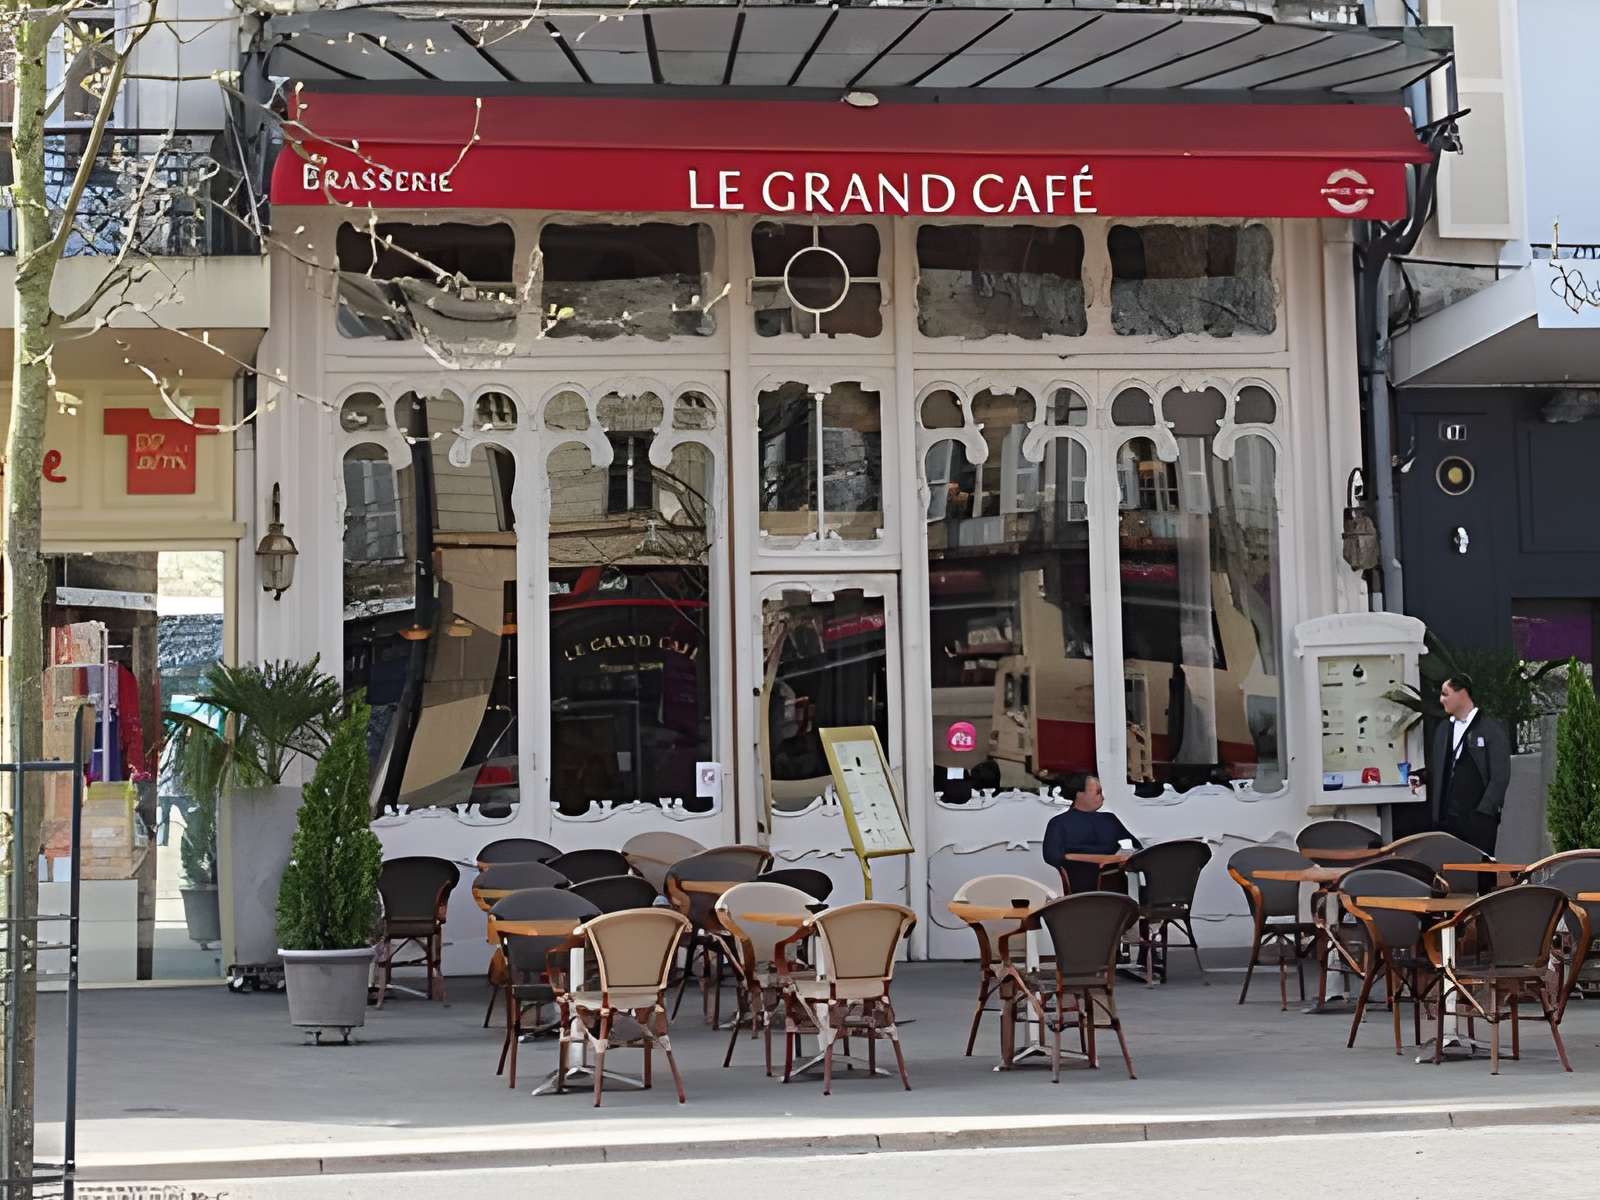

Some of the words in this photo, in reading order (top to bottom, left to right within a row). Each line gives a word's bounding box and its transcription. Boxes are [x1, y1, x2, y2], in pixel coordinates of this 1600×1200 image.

[688, 169, 745, 211] LE
[762, 170, 956, 213] GRAND
[972, 164, 1098, 214] CAFÉ
